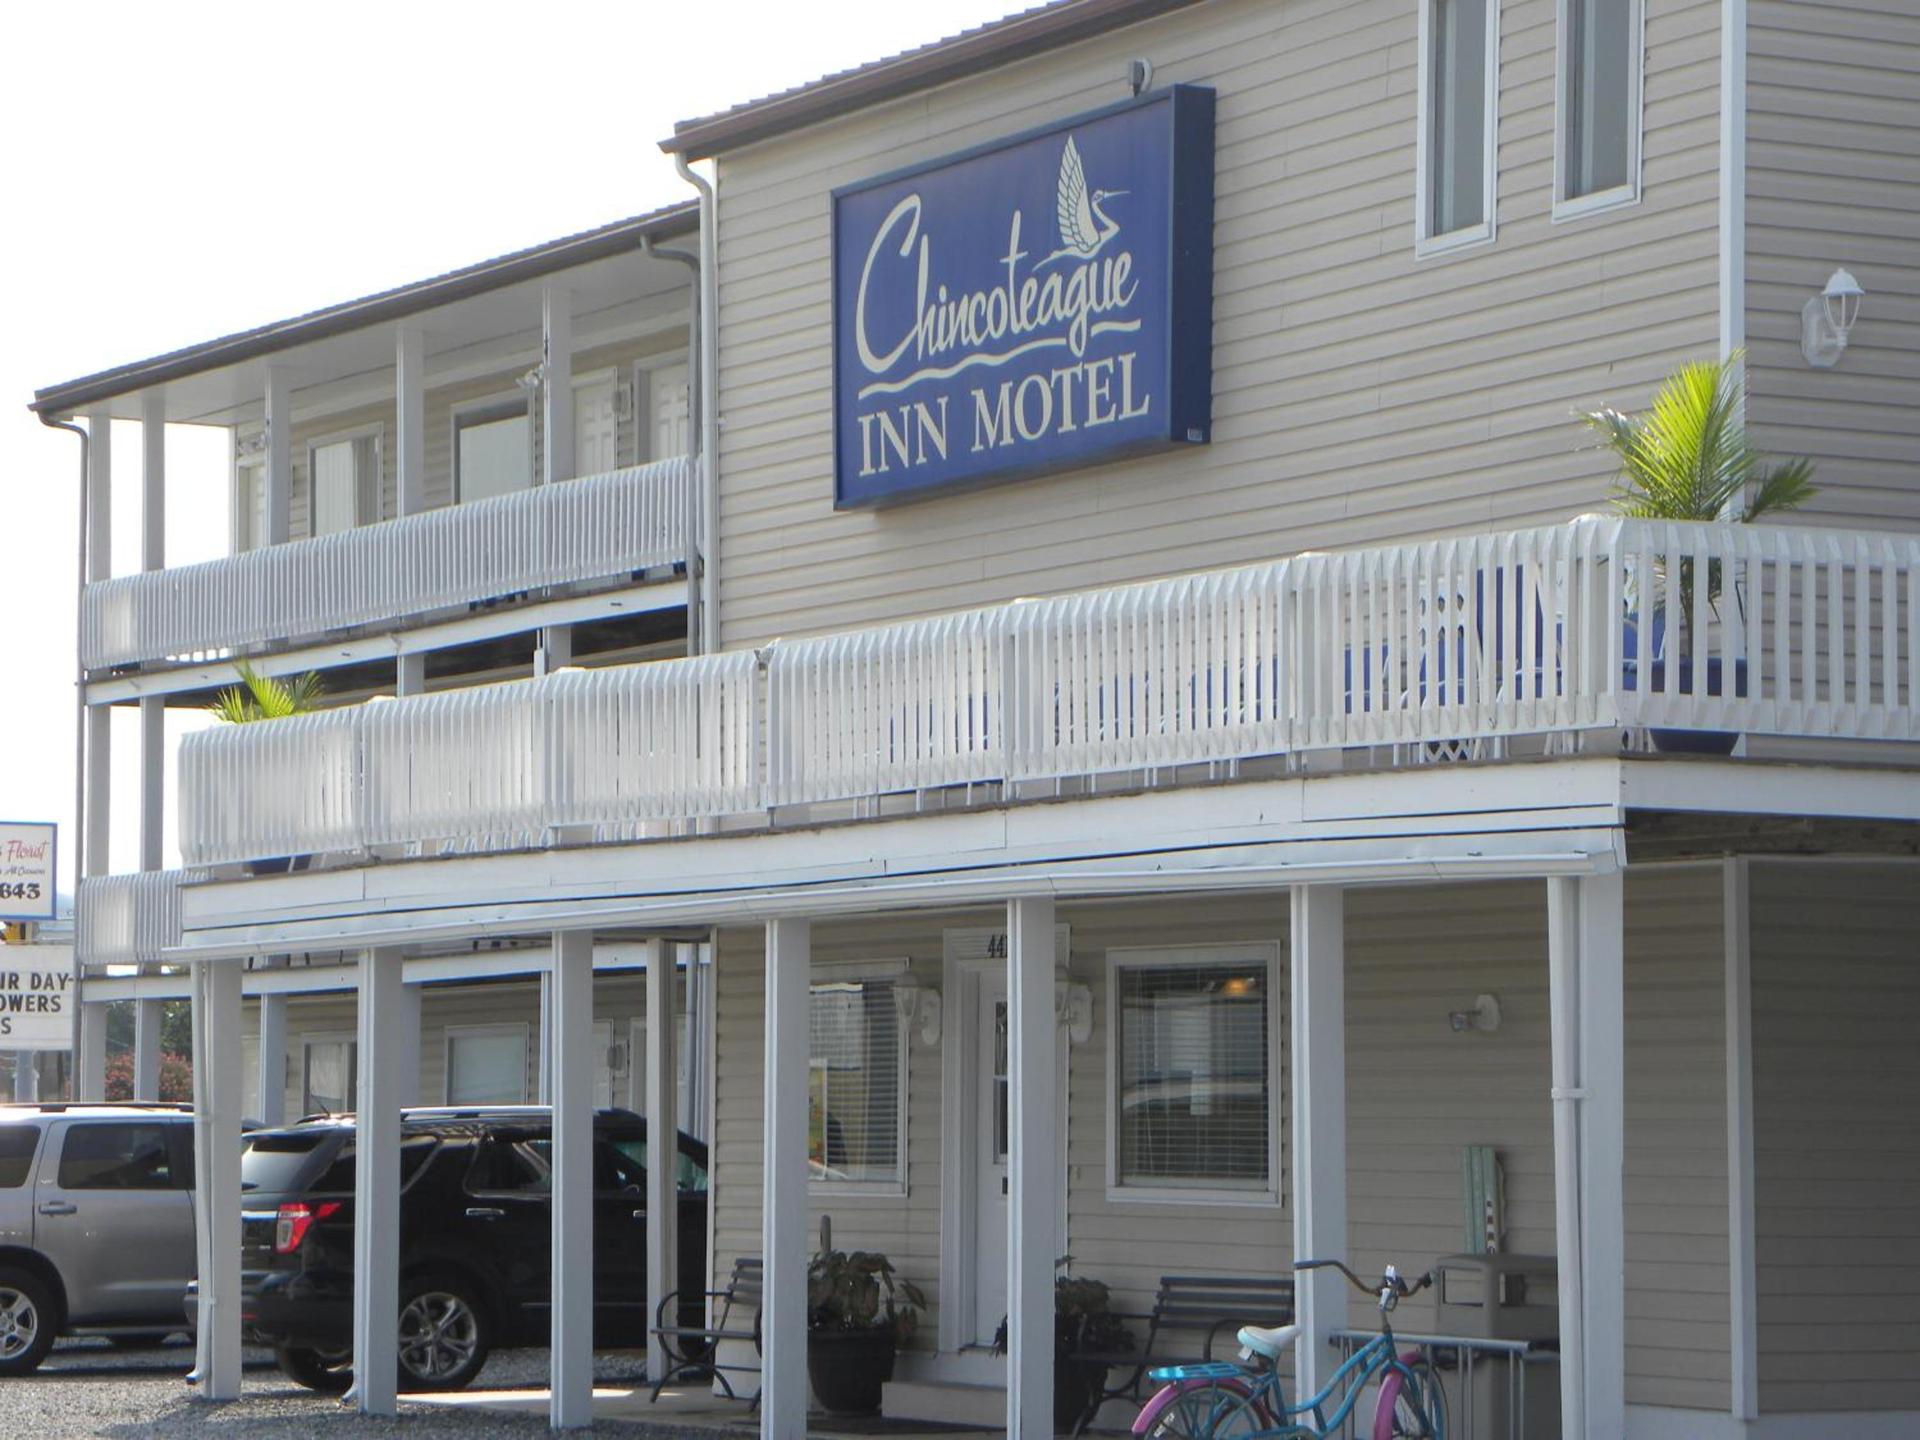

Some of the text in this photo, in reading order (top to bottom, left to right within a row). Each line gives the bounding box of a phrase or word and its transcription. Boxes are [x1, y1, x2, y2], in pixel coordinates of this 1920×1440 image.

[855, 193, 1139, 374] Chincoteague
[858, 352, 1150, 477] INN MOTEL
